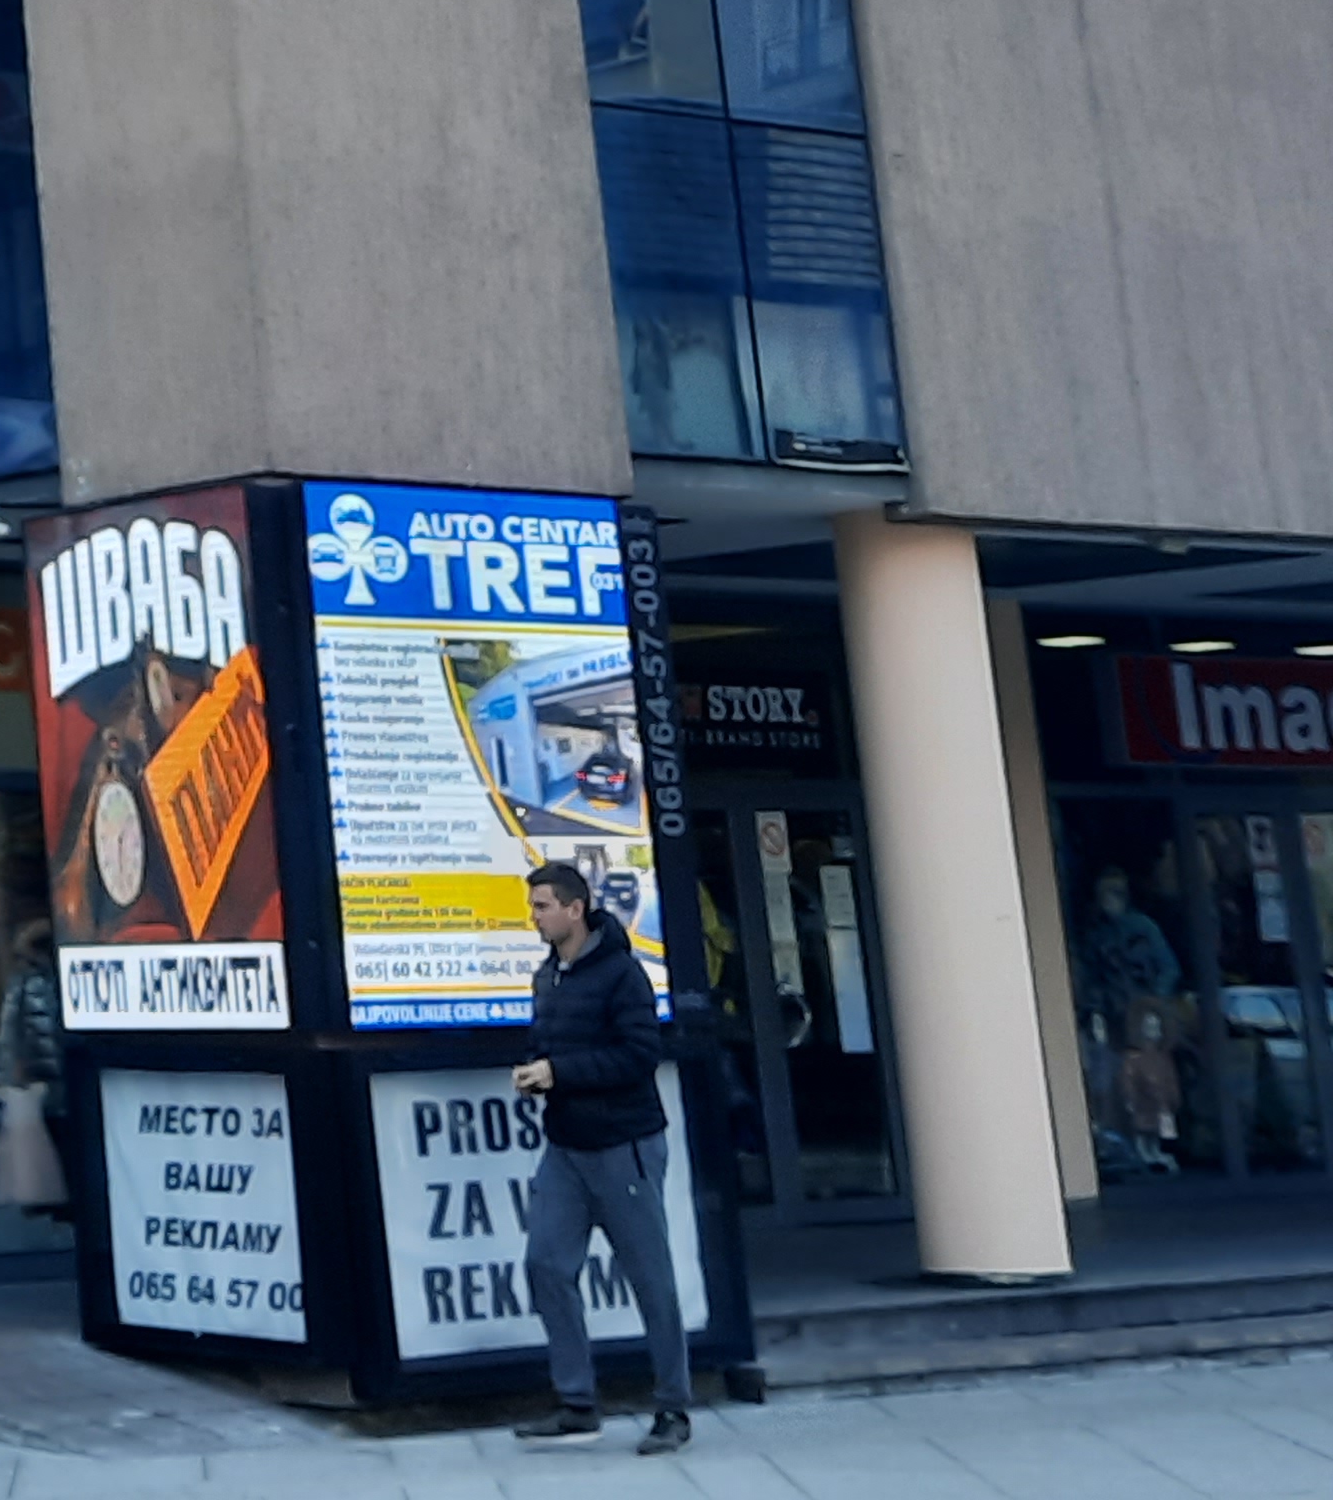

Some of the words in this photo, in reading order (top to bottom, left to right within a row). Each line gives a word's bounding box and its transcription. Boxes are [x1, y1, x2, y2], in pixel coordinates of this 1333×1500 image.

[408, 511, 495, 541] AUTO
[501, 515, 618, 547] CENTAR
[409, 538, 622, 617] TREF
[39, 516, 249, 700] ШВАБА
[1171, 660, 1333, 754] Ima
[414, 961, 432, 977] 42
[138, 1104, 242, 1137] МЕСТО
[251, 1106, 284, 1139] ЗА
[412, 1097, 542, 1158] PROS
[164, 1161, 254, 1195] ВАШУ
[425, 1180, 495, 1239] ZA
[144, 1216, 282, 1254] РЕКЛАМУ
[128, 1270, 177, 1303] 065
[186, 1274, 216, 1306] 64
[226, 1278, 260, 1310] 57
